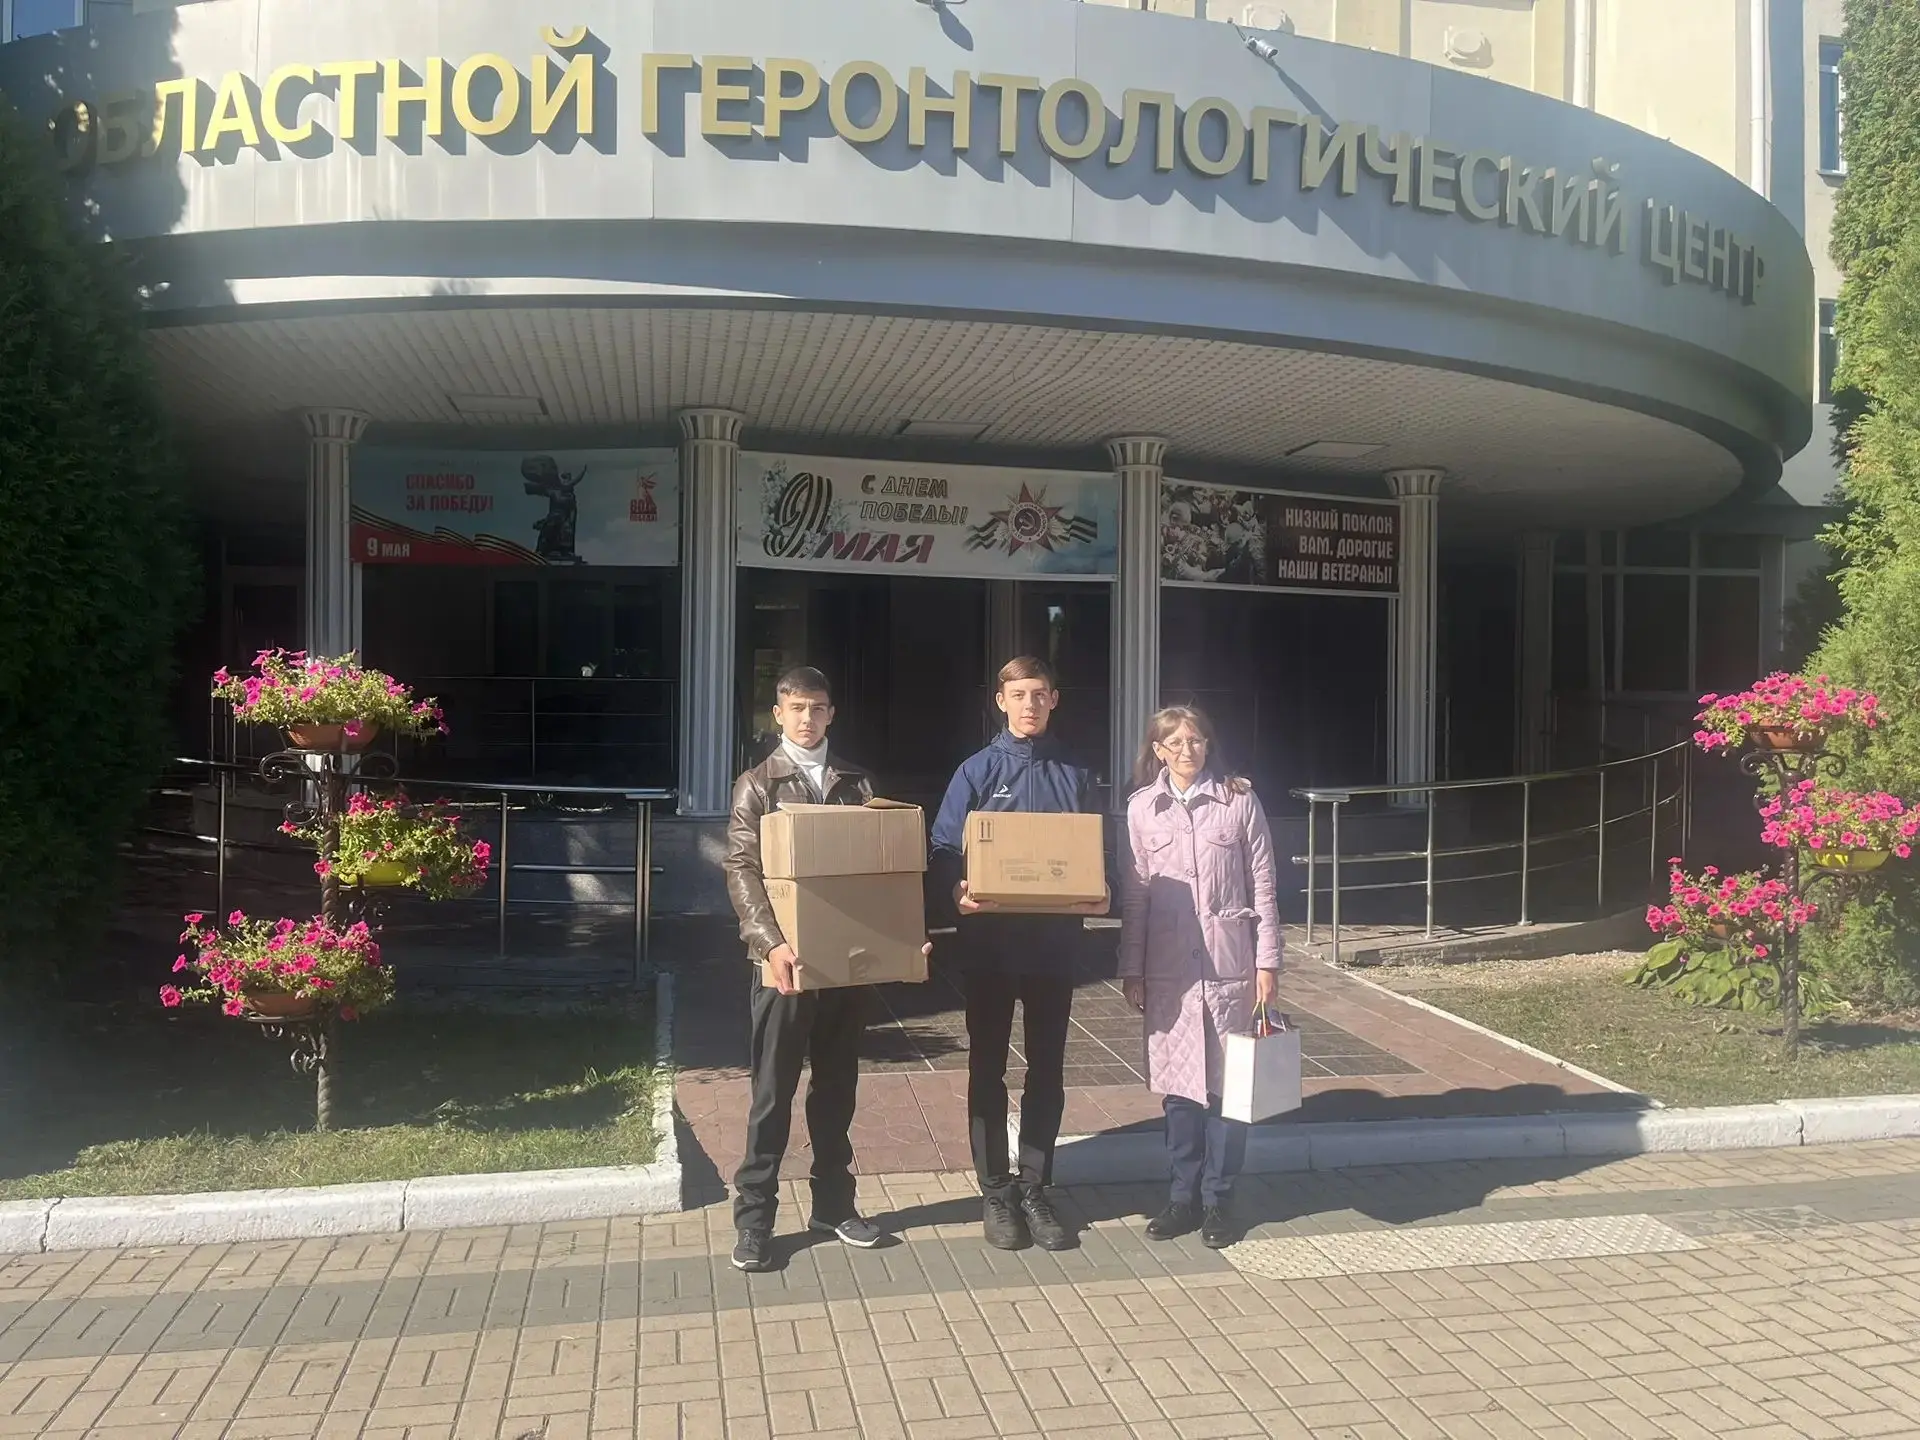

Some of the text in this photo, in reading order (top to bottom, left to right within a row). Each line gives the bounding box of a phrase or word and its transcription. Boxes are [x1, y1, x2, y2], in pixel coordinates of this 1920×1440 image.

[53, 25, 593, 173] ОБЛАСТНОЙ
[641, 53, 1627, 253] ГЕРОНТОЛОГИЧЕСКИЙ
[406, 474, 475, 490] СПАСИБО
[861, 474, 949, 499] С ДНЕМ
[406, 495, 494, 514] ЗА ПОБЕДУ!
[860, 501, 969, 526] ПОБЕДЫ!
[1285, 508, 1393, 534] НИЗКИЙ ПОКЛОН
[367, 537, 411, 558] 9 МАЯ
[812, 532, 935, 563] МАЯ
[1336, 538, 1394, 560] ДОРОГИЕ
[1278, 559, 1393, 584] НАШИ ВЕТЕРАНЫ!
